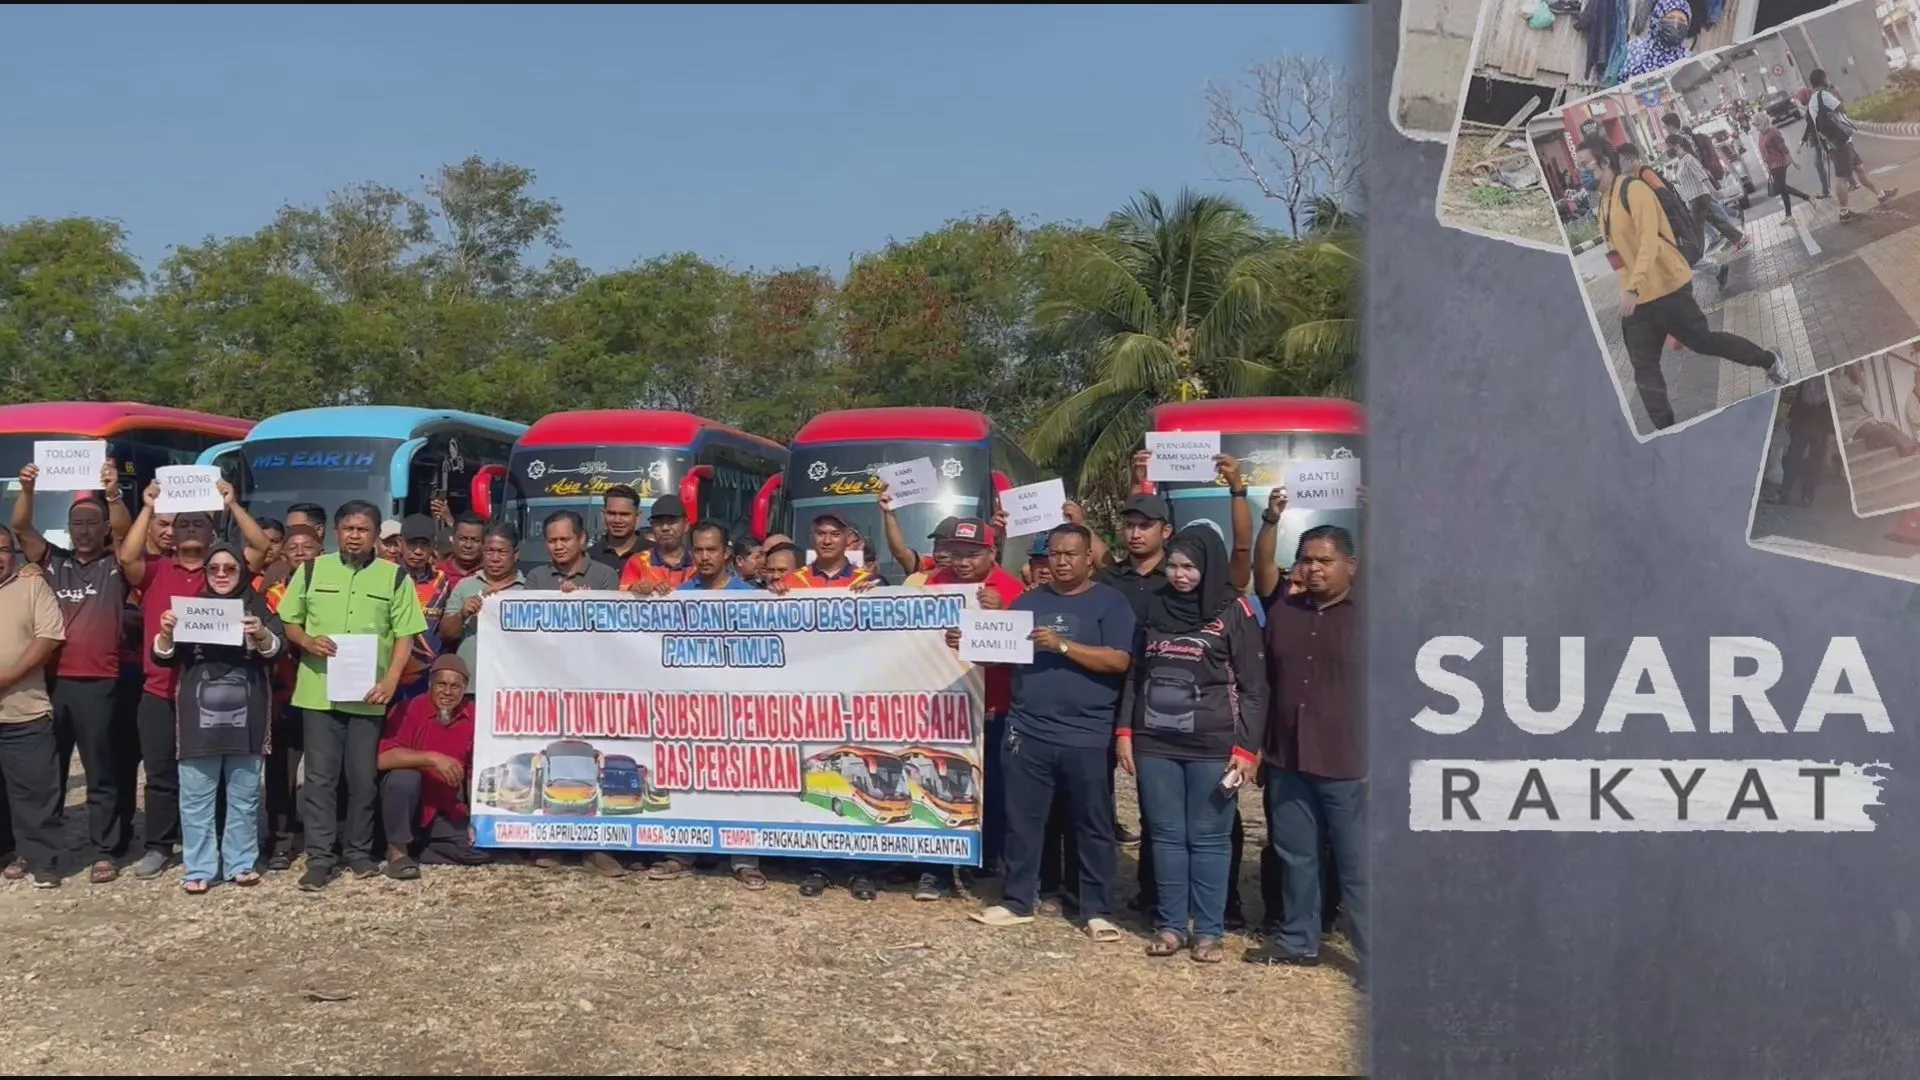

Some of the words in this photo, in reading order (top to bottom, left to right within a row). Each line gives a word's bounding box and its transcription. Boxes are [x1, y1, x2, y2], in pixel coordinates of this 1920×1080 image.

[45, 449, 90, 460] TOLONG
[253, 451, 288, 468] MS
[290, 450, 376, 468] EARTH
[46, 466, 75, 476] KAMI
[1299, 472, 1339, 482] BANTU
[168, 474, 211, 484] TOLONG
[545, 477, 582, 495] Asia
[823, 477, 864, 495] Asia
[168, 490, 196, 499] KAMI
[1297, 489, 1328, 499] KAMI
[187, 607, 224, 617] BANTU
[502, 601, 583, 630] HIMPUNAN
[585, 601, 684, 630] PENGUSAHA
[686, 601, 723, 630] DAN
[727, 600, 816, 630] PEMANDU
[818, 598, 855, 630] BAS
[859, 596, 961, 629] PERSIARAN
[185, 621, 213, 631] KAMI
[975, 622, 1013, 632] BANTU
[665, 636, 724, 665] PANTAI
[727, 636, 783, 665] TIMUR
[971, 640, 1001, 649] KAMI
[494, 690, 560, 734] MOHON
[563, 691, 649, 736] TUNTUTAN
[654, 692, 726, 738] SUBSIDI
[655, 743, 690, 788] BAS
[695, 745, 799, 791] PERSIARAN
[497, 824, 529, 840] TARIKH
[536, 825, 548, 840] 06
[577, 825, 599, 841] 2025
[600, 825, 632, 844] (ISNIN)
[638, 826, 664, 842] MASA
[691, 828, 712, 845] PAGI
[720, 829, 756, 846] TEMPAT
[762, 831, 819, 849] PENGKALAN
